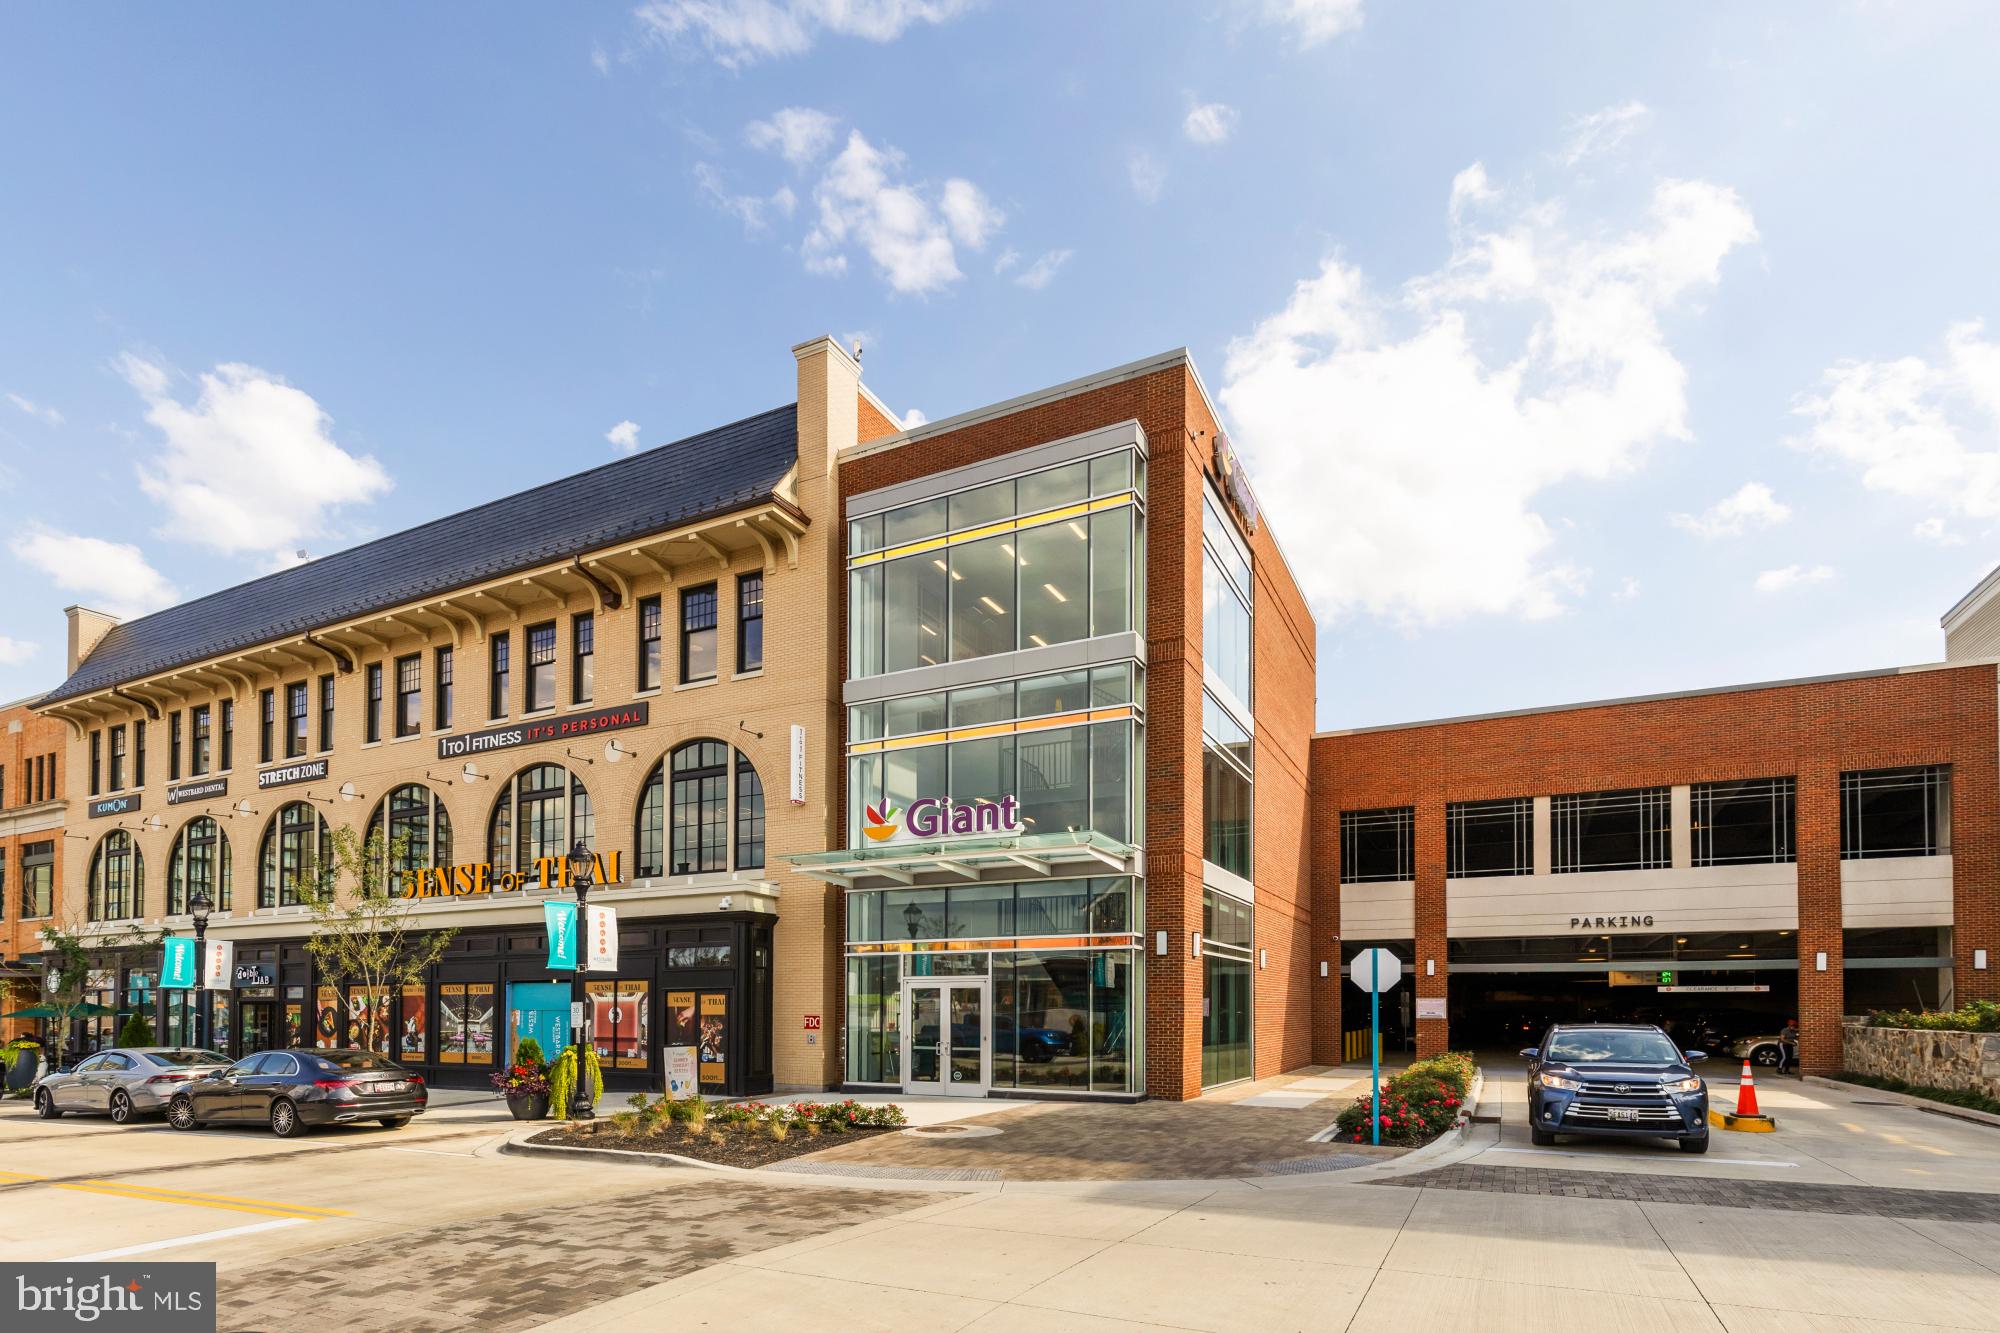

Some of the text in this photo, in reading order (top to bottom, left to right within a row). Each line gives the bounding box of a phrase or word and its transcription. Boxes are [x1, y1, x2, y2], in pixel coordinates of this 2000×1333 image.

[472, 731, 522, 751] FITNESS
[528, 727, 555, 740] IT'S
[561, 711, 641, 734] PERSONAL
[259, 762, 325, 785] STRETCH ZONE
[178, 787, 204, 797] WESTBARD
[204, 783, 224, 793] DENTAL
[97, 799, 128, 813] KUMON
[906, 795, 1018, 837] Giant
[500, 872, 526, 892] OF
[1571, 915, 1654, 928] PARKING
[557, 910, 567, 959] Welcome!
[804, 1017, 820, 1028] FDC
